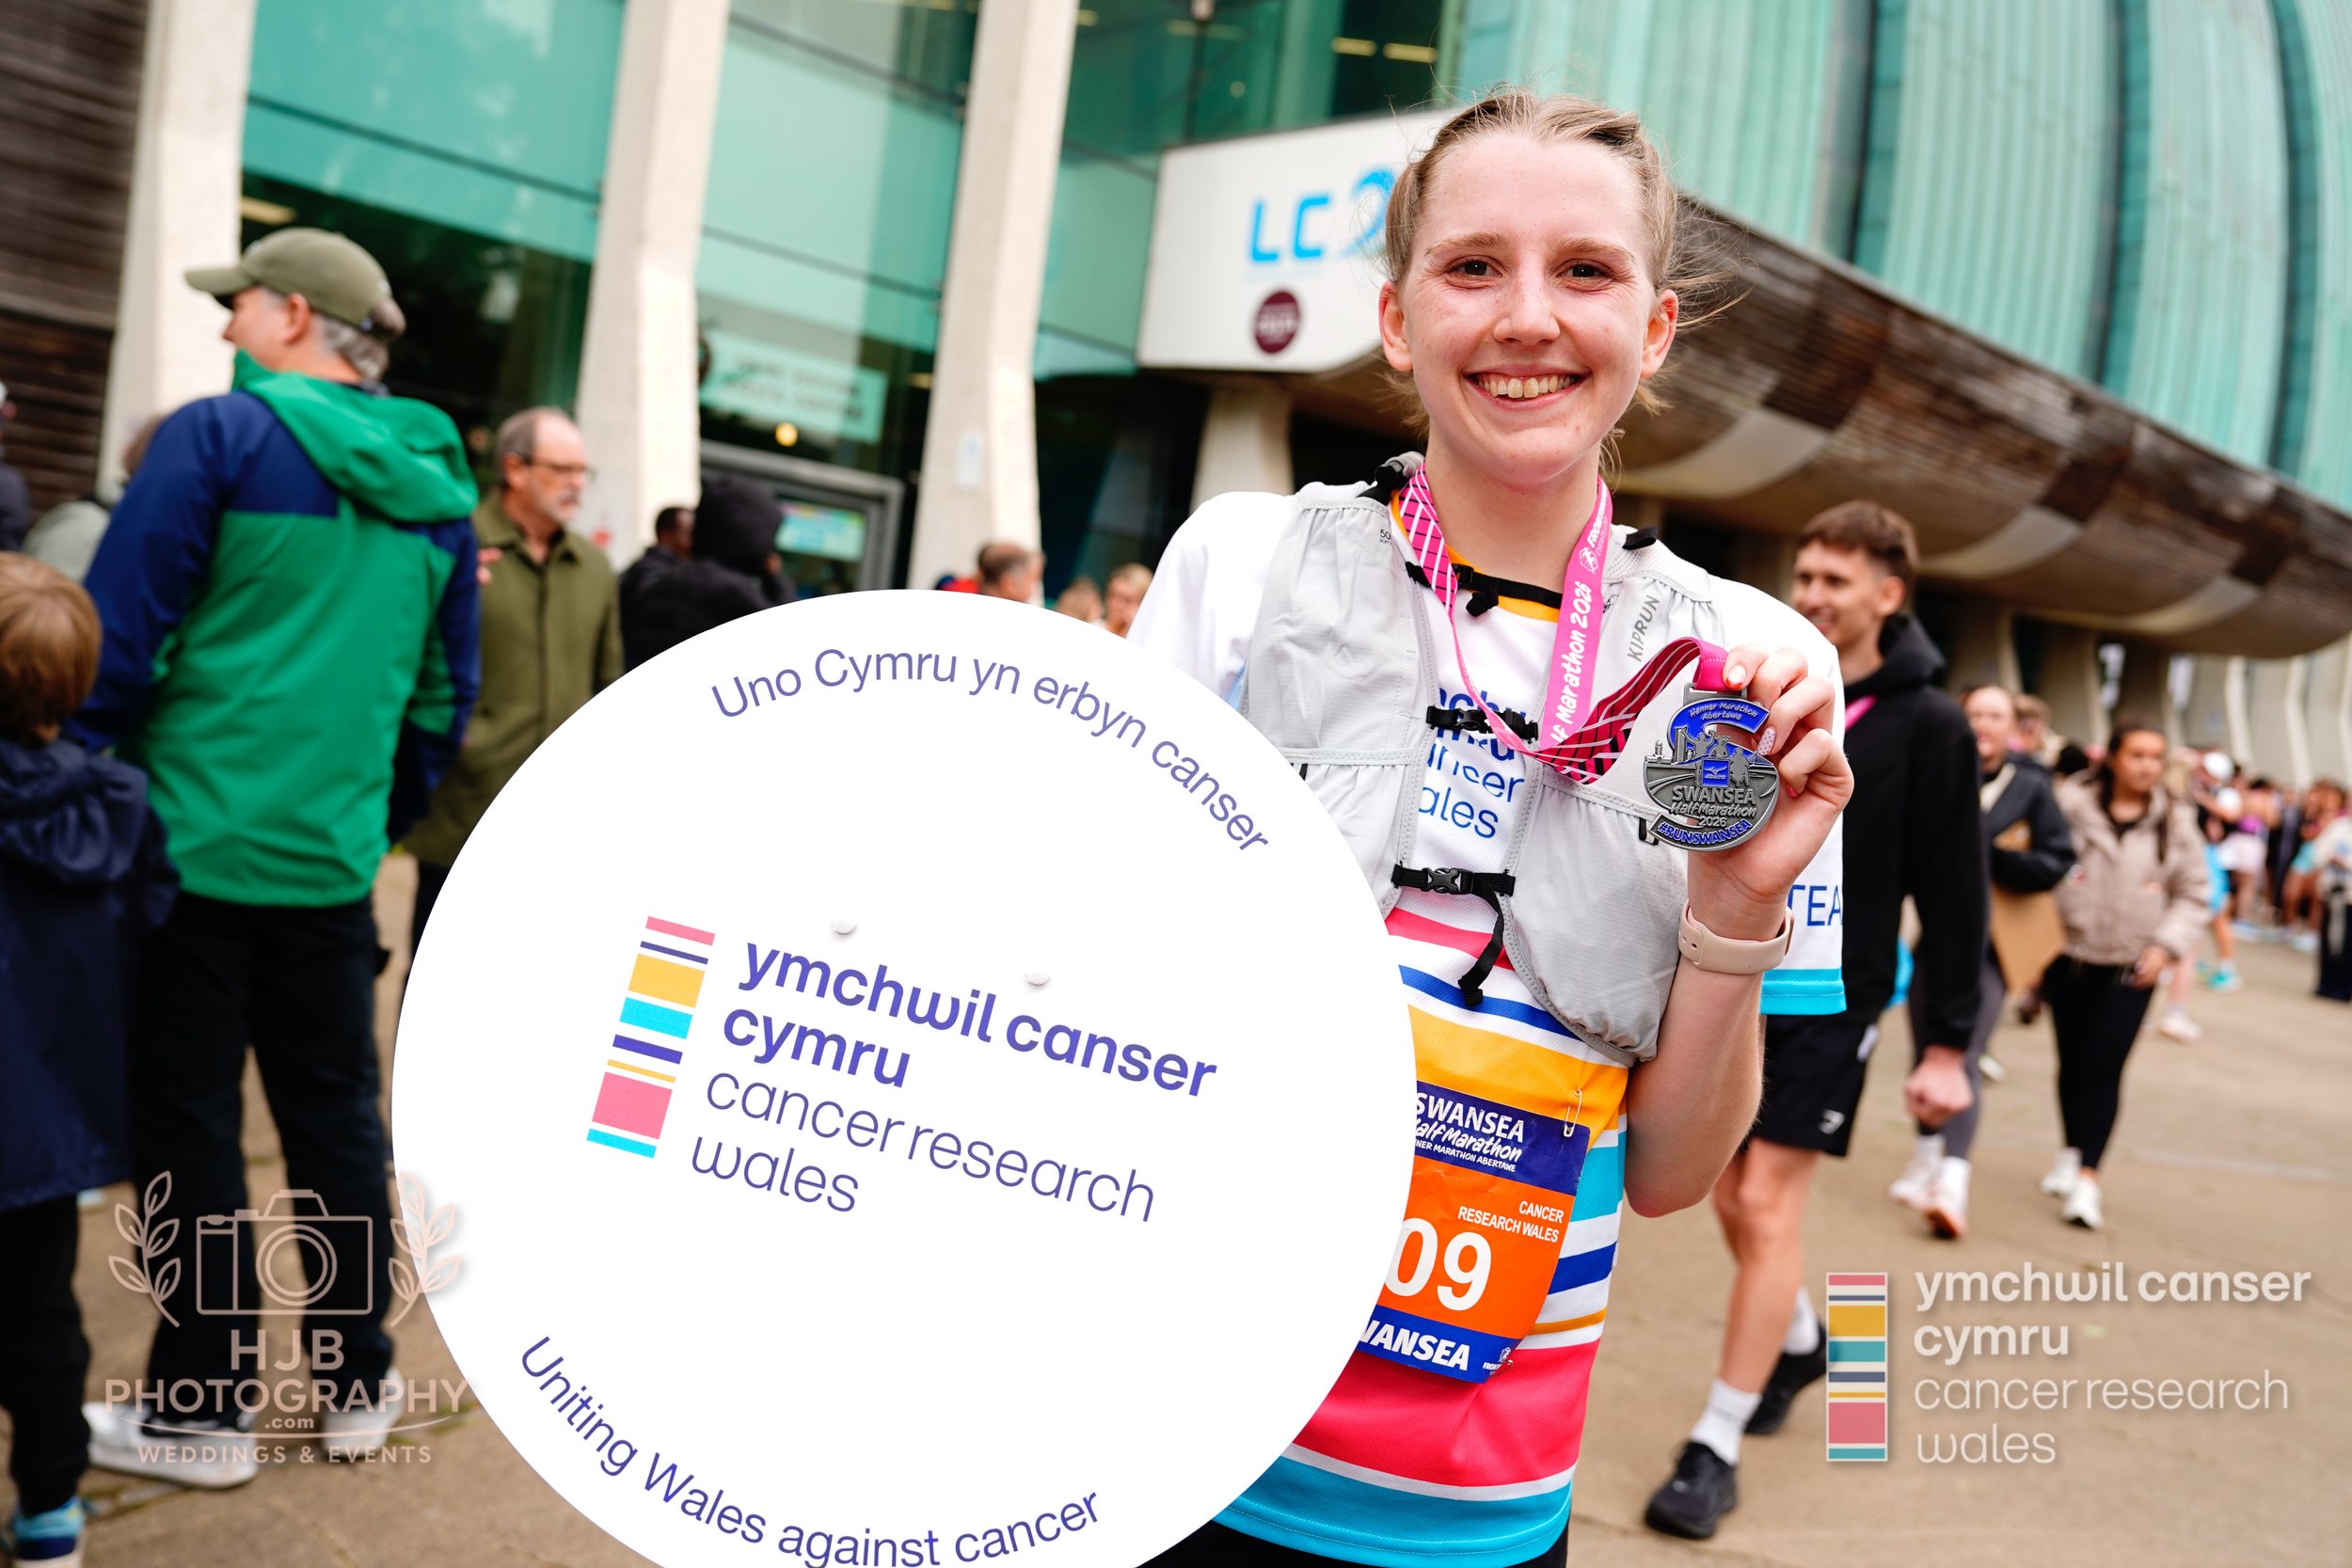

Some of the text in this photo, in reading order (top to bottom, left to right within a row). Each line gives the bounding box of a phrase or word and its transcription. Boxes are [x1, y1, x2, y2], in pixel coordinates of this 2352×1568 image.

[1570, 580, 1592, 629] 2026
[1627, 594, 1661, 662] KIPRUN
[1555, 629, 1589, 724] Marathon
[1701, 710, 1742, 721] Abertawe
[1719, 702, 1758, 718] Marathon
[712, 648, 1269, 850] Uno Cymru yn erbyn canser
[1421, 786, 1499, 838] ales
[1672, 785, 1756, 805] SWANSEA
[1657, 818, 1753, 845] #RUNSWANSEA
[1698, 816, 1726, 828] 2026
[739, 942, 1217, 1097] ymchwil canser
[723, 1008, 911, 1088] cymru
[1416, 1092, 1524, 1143] SWANSEA
[1416, 1117, 1523, 1163] alf Marathon
[707, 1072, 1154, 1222] cancer research
[1433, 1144, 1477, 1163] MARATHON
[1476, 1155, 1517, 1173] ABERTAWE
[691, 1136, 858, 1212] wales
[1457, 1206, 1559, 1243] RESEARCH WALES
[1519, 1200, 1564, 1224] CANCER
[1384, 1217, 1492, 1311] 09
[521, 1336, 1098, 1568] Uniting Wales against cancer
